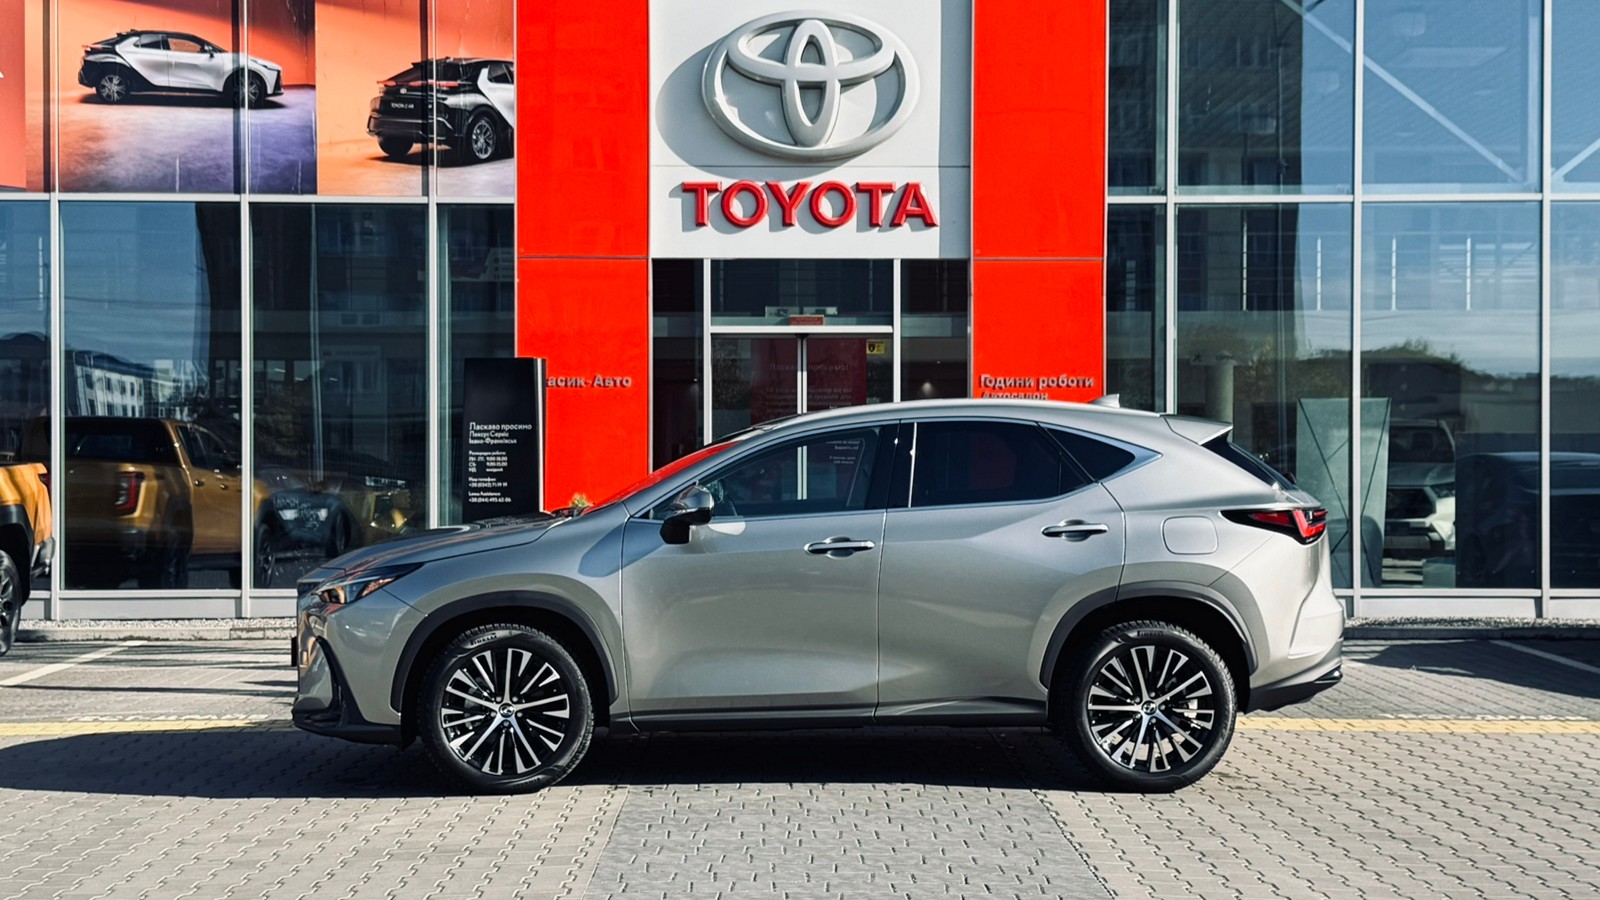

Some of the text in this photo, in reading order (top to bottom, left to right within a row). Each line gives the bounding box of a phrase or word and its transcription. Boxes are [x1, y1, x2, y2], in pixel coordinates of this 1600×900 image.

[682, 180, 940, 228] TOYOTA
[546, 374, 632, 388] асик-Авто
[980, 374, 1094, 390] Години роботи
[469, 422, 500, 430] Ласкаво
